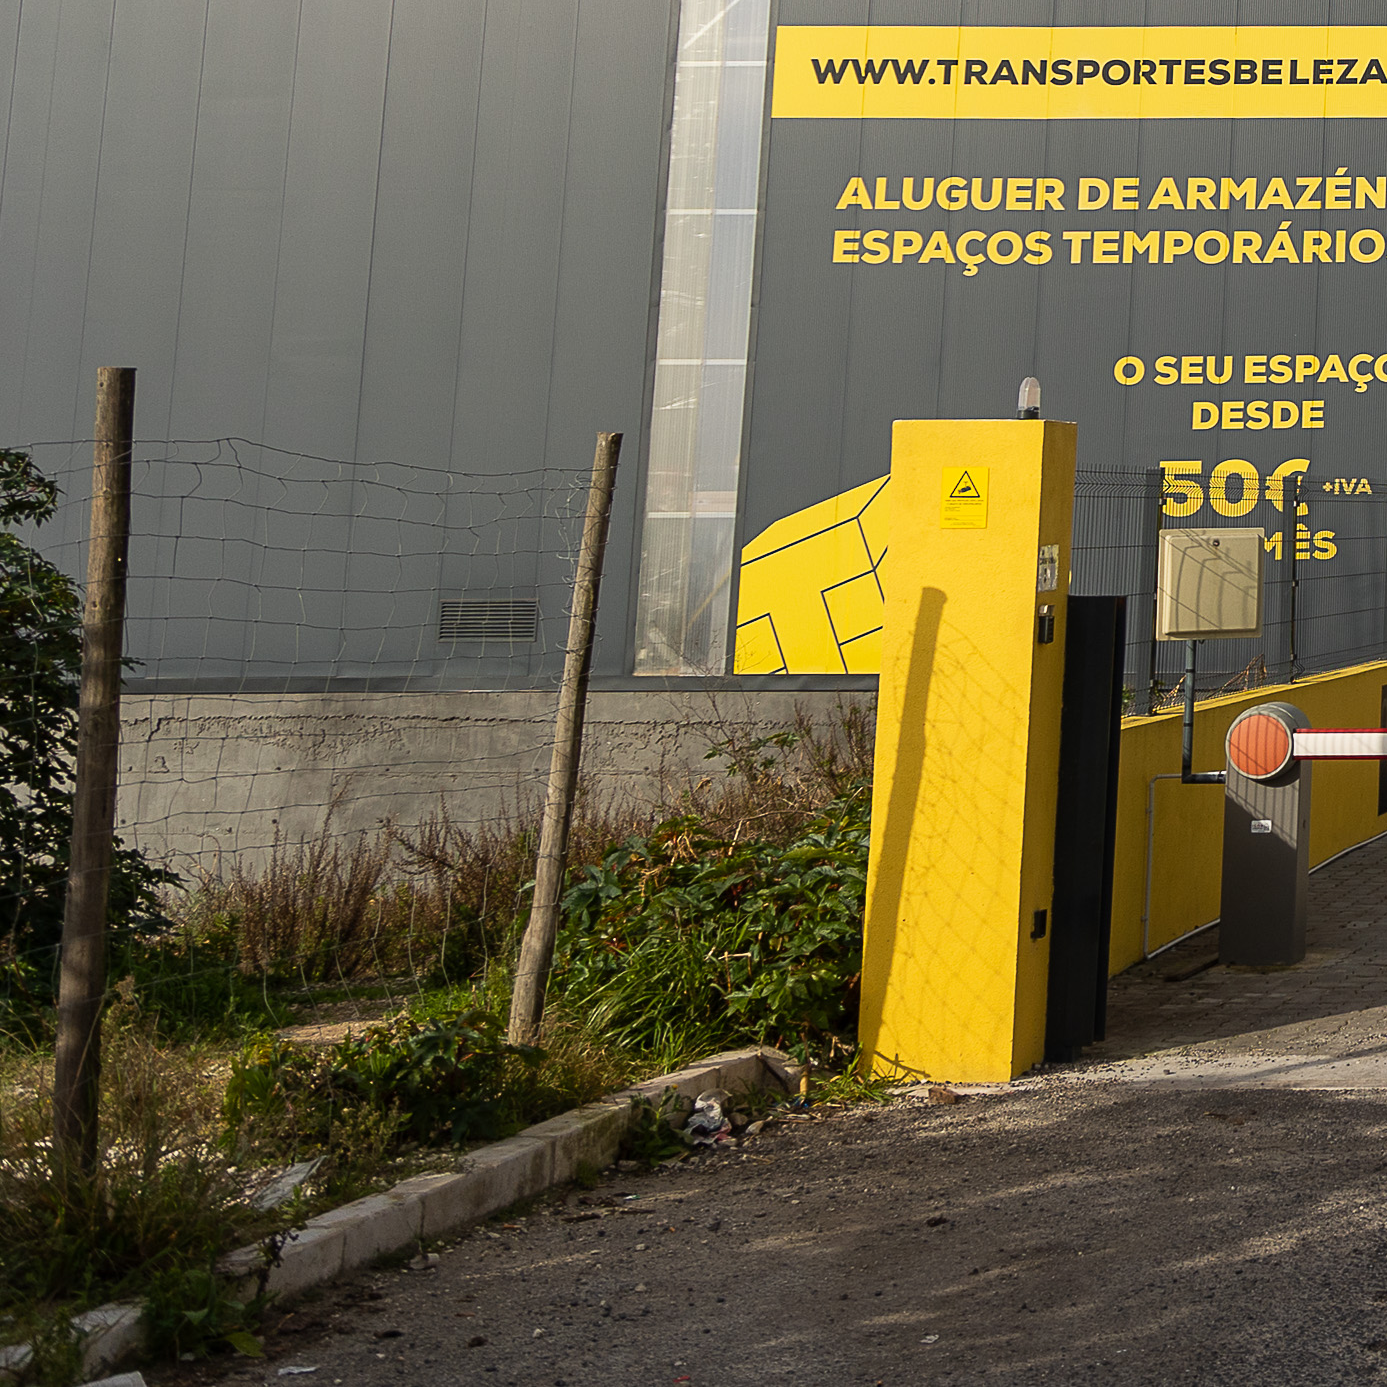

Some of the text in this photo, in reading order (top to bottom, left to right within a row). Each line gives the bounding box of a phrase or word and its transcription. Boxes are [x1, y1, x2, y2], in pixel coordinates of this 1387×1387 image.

[835, 176, 1065, 211] ALUGUER
[1077, 177, 1139, 211] DE
[831, 230, 1053, 276] ESPAÇOS
[1113, 355, 1146, 386] O
[1153, 355, 1233, 386] SEU
[1192, 399, 1325, 431] DESDE
[1159, 458, 1374, 518] 50€ +IVA
